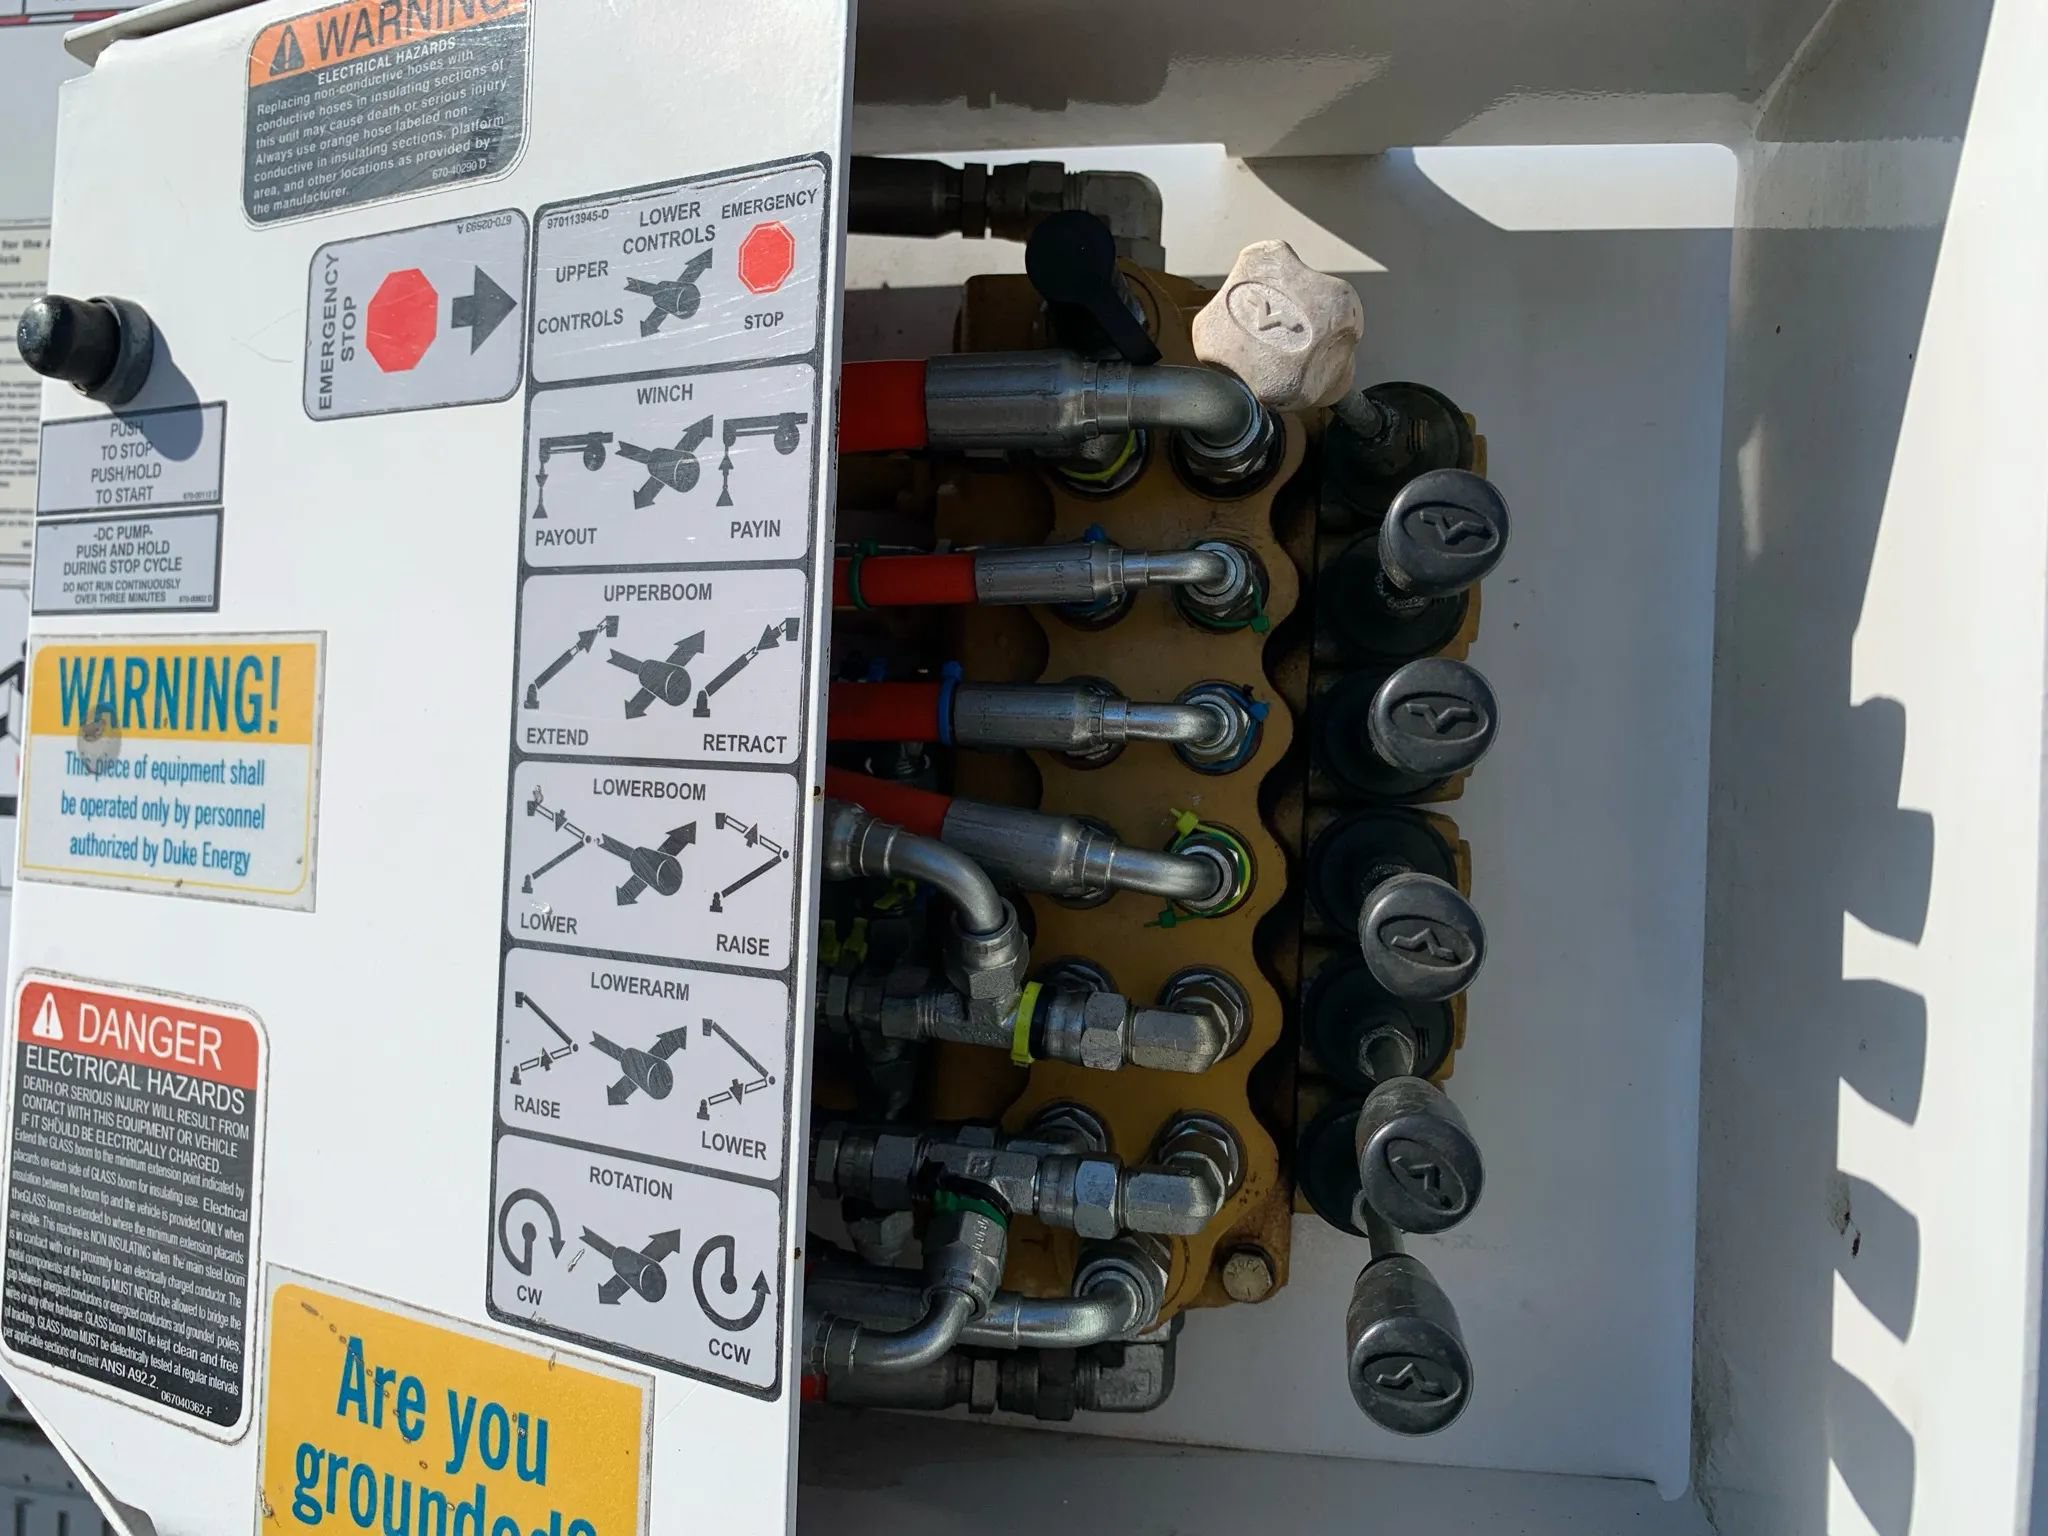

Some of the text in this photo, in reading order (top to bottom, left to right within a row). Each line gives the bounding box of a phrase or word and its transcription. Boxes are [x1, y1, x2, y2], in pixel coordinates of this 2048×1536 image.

[318, 37, 456, 86] ELECTRICAL HAZARDS
[256, 58, 504, 132] conductive hoses in insulating sections of
[257, 50, 473, 116] Replacing non-conductive hoses with
[256, 137, 275, 149] this
[279, 130, 300, 143] unit
[303, 124, 326, 137] may
[330, 114, 363, 130] cause
[367, 104, 400, 121] death
[404, 100, 417, 112] or
[421, 88, 466, 108] serious
[256, 105, 472, 166] Always use orange hose labeled non-
[254, 159, 313, 182] conductive
[317, 157, 327, 168] in
[331, 143, 388, 164] insulating
[452, 116, 504, 139] platform
[254, 137, 490, 200] area, and other locations as provided by
[480, 159, 486, 169] D
[253, 187, 350, 215] the manufacturer.
[547, 188, 818, 229] 970113945-D LOWER EMERGENCY
[457, 224, 464, 234] A
[623, 224, 716, 254] CONTROLS
[556, 260, 609, 283] UPPER
[318, 253, 339, 410] EMERGENCY
[341, 296, 357, 361] STOP
[537, 308, 784, 334] CONTROLS STOP
[636, 383, 694, 405] WINCH
[110, 420, 143, 437] PUSH
[101, 440, 153, 460] TO STOP
[91, 462, 162, 483] PUSH/HOLD
[96, 486, 154, 504] TO START
[76, 540, 170, 559] PUSH AND HOLD
[93, 527, 113, 541] -DC
[535, 519, 781, 546] PAYOUT PAYIN
[63, 557, 182, 576] DURING STOP CYCLE
[63, 579, 181, 593] DO NOT RUN CONTINUOUSLY
[75, 594, 97, 605] OVER
[99, 592, 126, 604] THREE
[128, 592, 166, 603] MINUTES
[603, 582, 712, 602] UPPERBOOM
[59, 655, 281, 734] WARNING!
[526, 728, 787, 754] EXTEND RETRACT
[66, 751, 265, 786] This piece of equipment shall
[593, 778, 706, 801] LOWERBOOM
[61, 790, 265, 830] be operated only by personnel
[70, 833, 251, 877] authorized by Duke Energy
[520, 912, 770, 957] LOWER RAISE
[590, 971, 690, 1001] LOWERARM
[78, 1003, 222, 1071] DANGER
[26, 1045, 245, 1115] ELECTRICAL HAZARDS
[22, 1093, 238, 1158] CONTACT WITH THIS EQUIPMENT OR VEHICLE
[23, 1075, 249, 1140] DEATH OR SERIOUS INJURY WILL RESULT FROM
[514, 1094, 767, 1160] RAISE LOWER
[21, 1112, 222, 1175] IF IT SHOULD BE ELECTRICALLY CHARGED.
[590, 1166, 673, 1200] ROTATION
[517, 1285, 751, 1365] CW CCW
[3, 1326, 13, 1339] per
[14, 1330, 43, 1348] applicable
[44, 1340, 69, 1358] sections
[70, 1348, 76, 1360] of
[100, 1357, 125, 1377] ANSI
[127, 1367, 159, 1390] A92.2.
[37, 1316, 60, 1334] GLASS
[61, 1323, 78, 1341] boom
[80, 1330, 99, 1348] MUST
[100, 1337, 109, 1351] be
[110, 1340, 149, 1368] dielectrically
[150, 1354, 172, 1376] tested
[173, 1364, 180, 1376] at
[182, 1367, 208, 1384] regular
[208, 1373, 239, 1396] intervals
[161, 1390, 212, 1417] 067040362-F
[336, 1335, 548, 1487] Are you
[291, 1441, 597, 1536] ground
